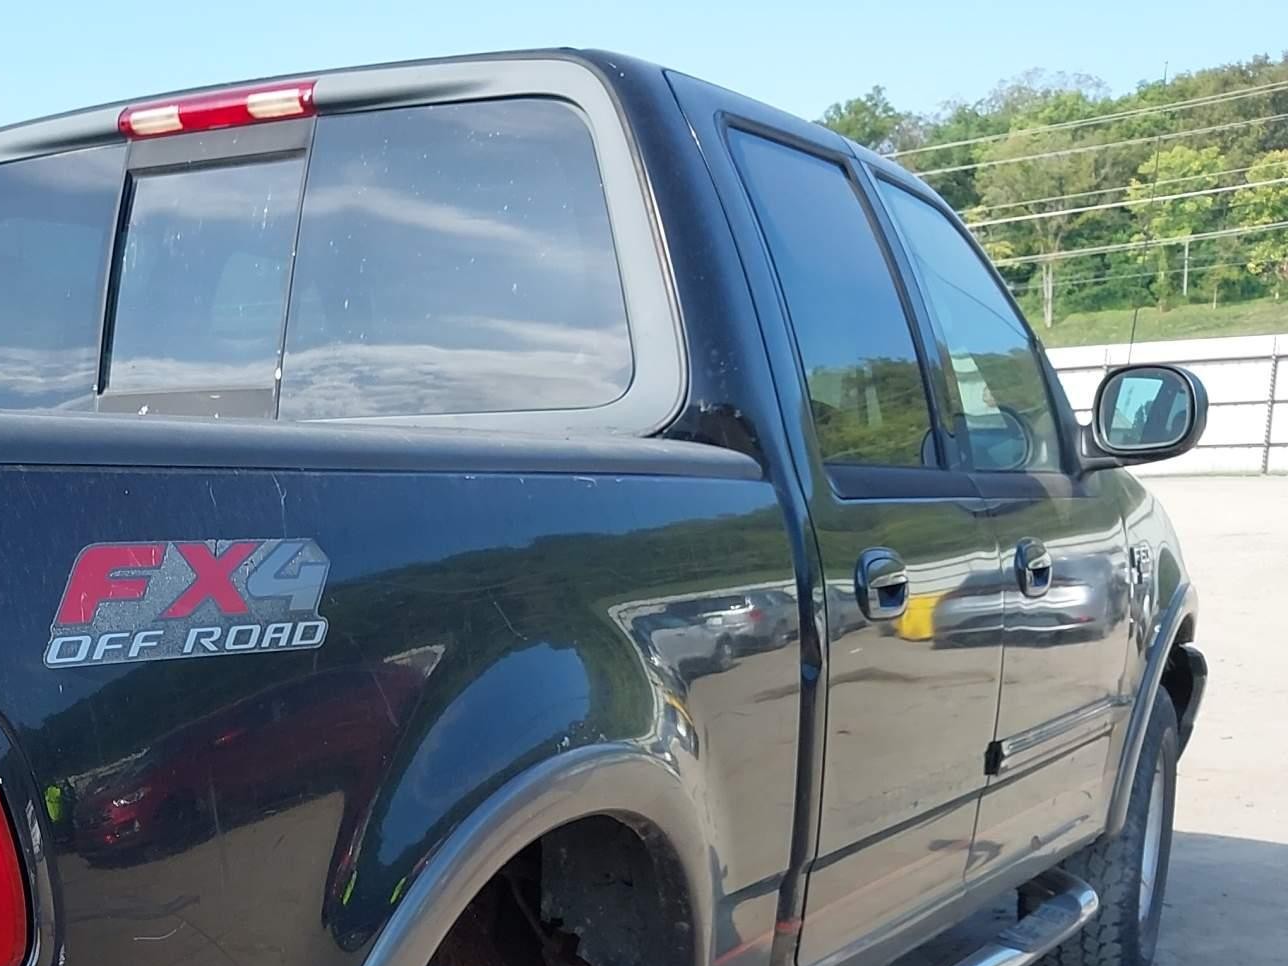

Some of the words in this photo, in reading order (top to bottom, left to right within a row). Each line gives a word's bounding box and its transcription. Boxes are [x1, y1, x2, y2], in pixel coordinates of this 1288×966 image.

[56, 541, 329, 625] FX4
[47, 630, 164, 665] OFF
[182, 621, 327, 653] ROAD
